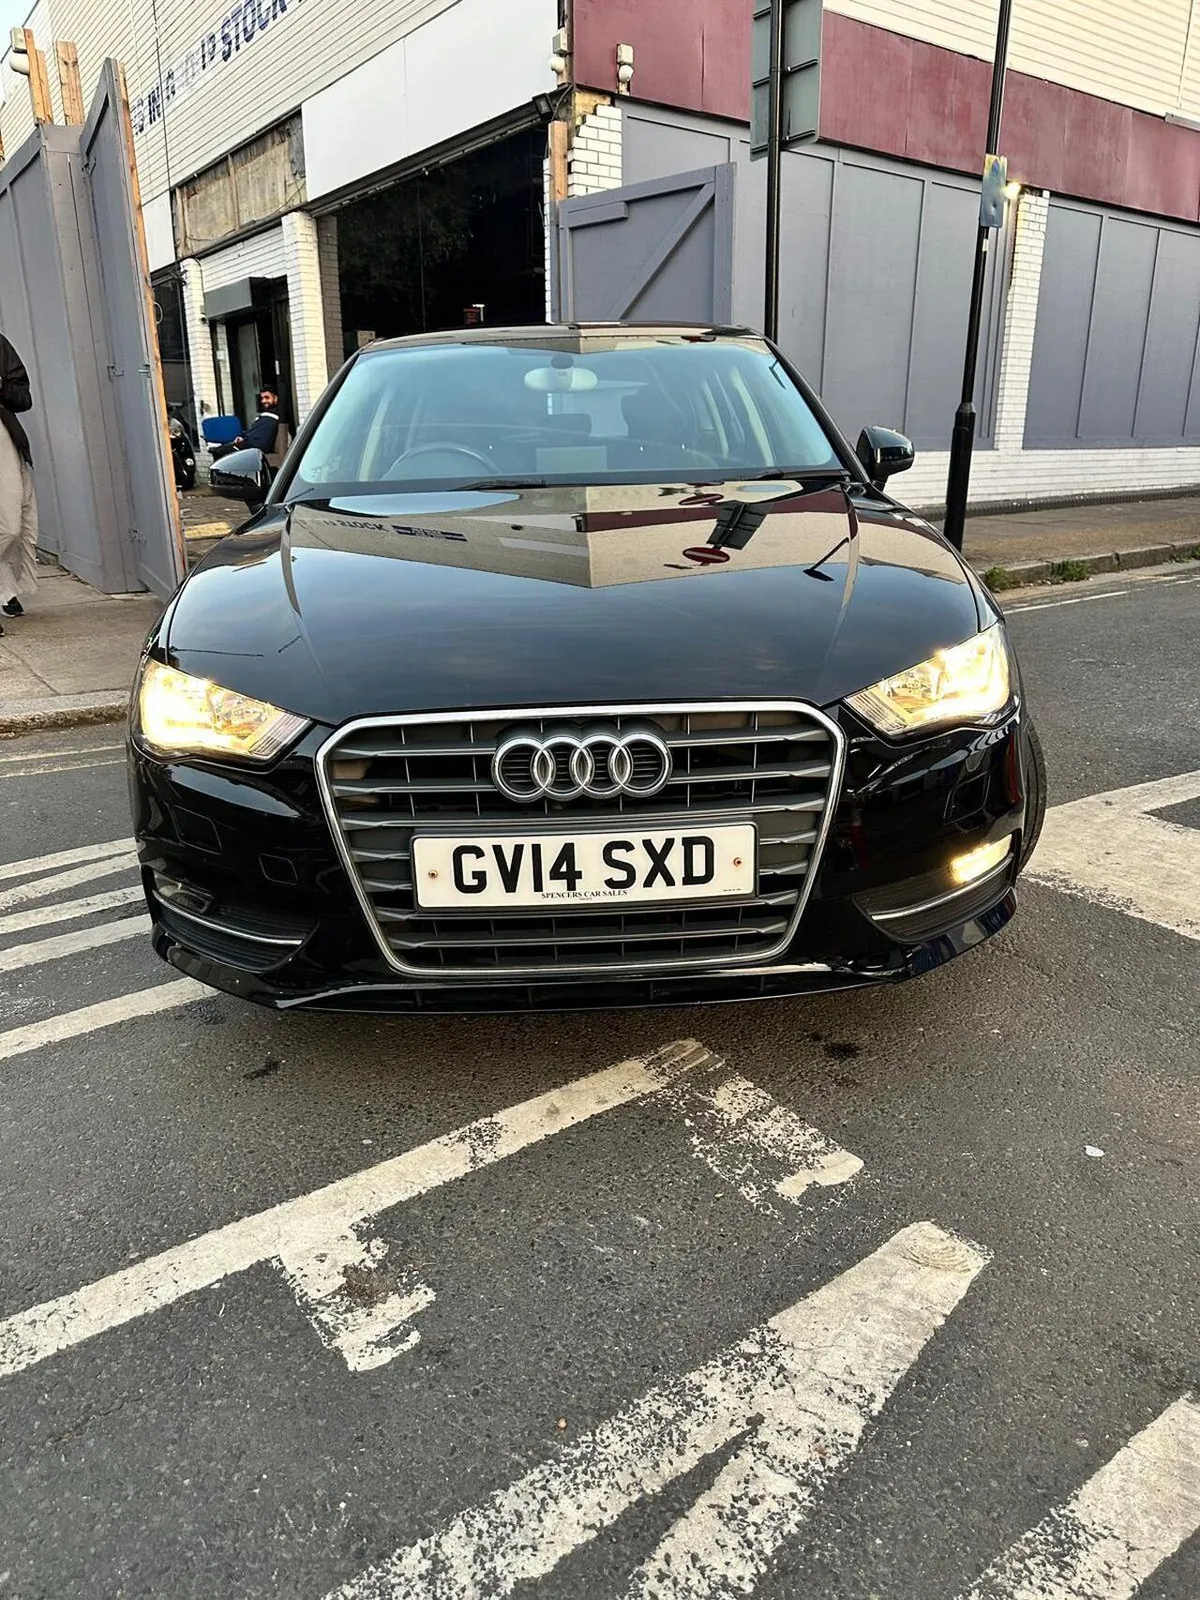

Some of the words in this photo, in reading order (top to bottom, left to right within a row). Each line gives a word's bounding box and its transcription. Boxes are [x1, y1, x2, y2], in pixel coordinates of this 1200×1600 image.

[452, 842, 583, 894] GV14
[602, 835, 715, 890] SXD
[541, 891, 582, 899] SPENCERS
[584, 890, 601, 898] CAR
[602, 889, 628, 897] SALES
